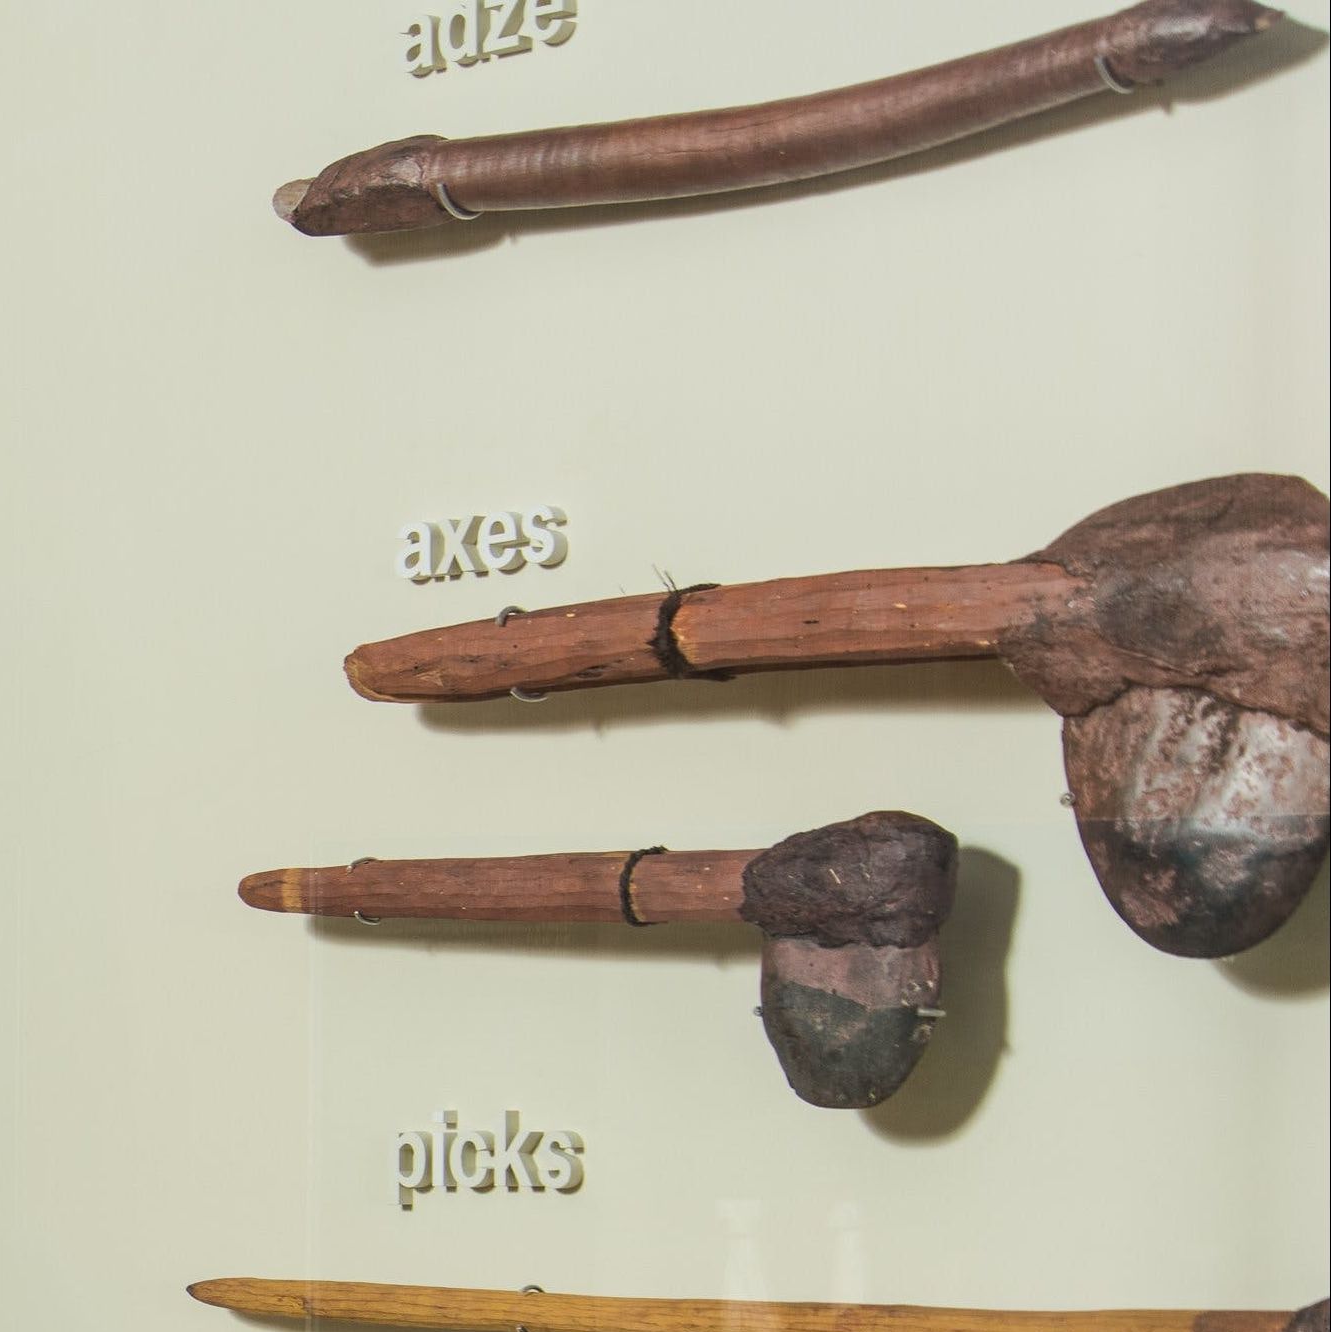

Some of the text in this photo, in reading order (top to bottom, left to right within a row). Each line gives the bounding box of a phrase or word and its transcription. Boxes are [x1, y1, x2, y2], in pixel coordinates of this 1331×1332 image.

[397, 0, 578, 77] adze
[396, 503, 569, 585] axes
[394, 1108, 586, 1211] picks
